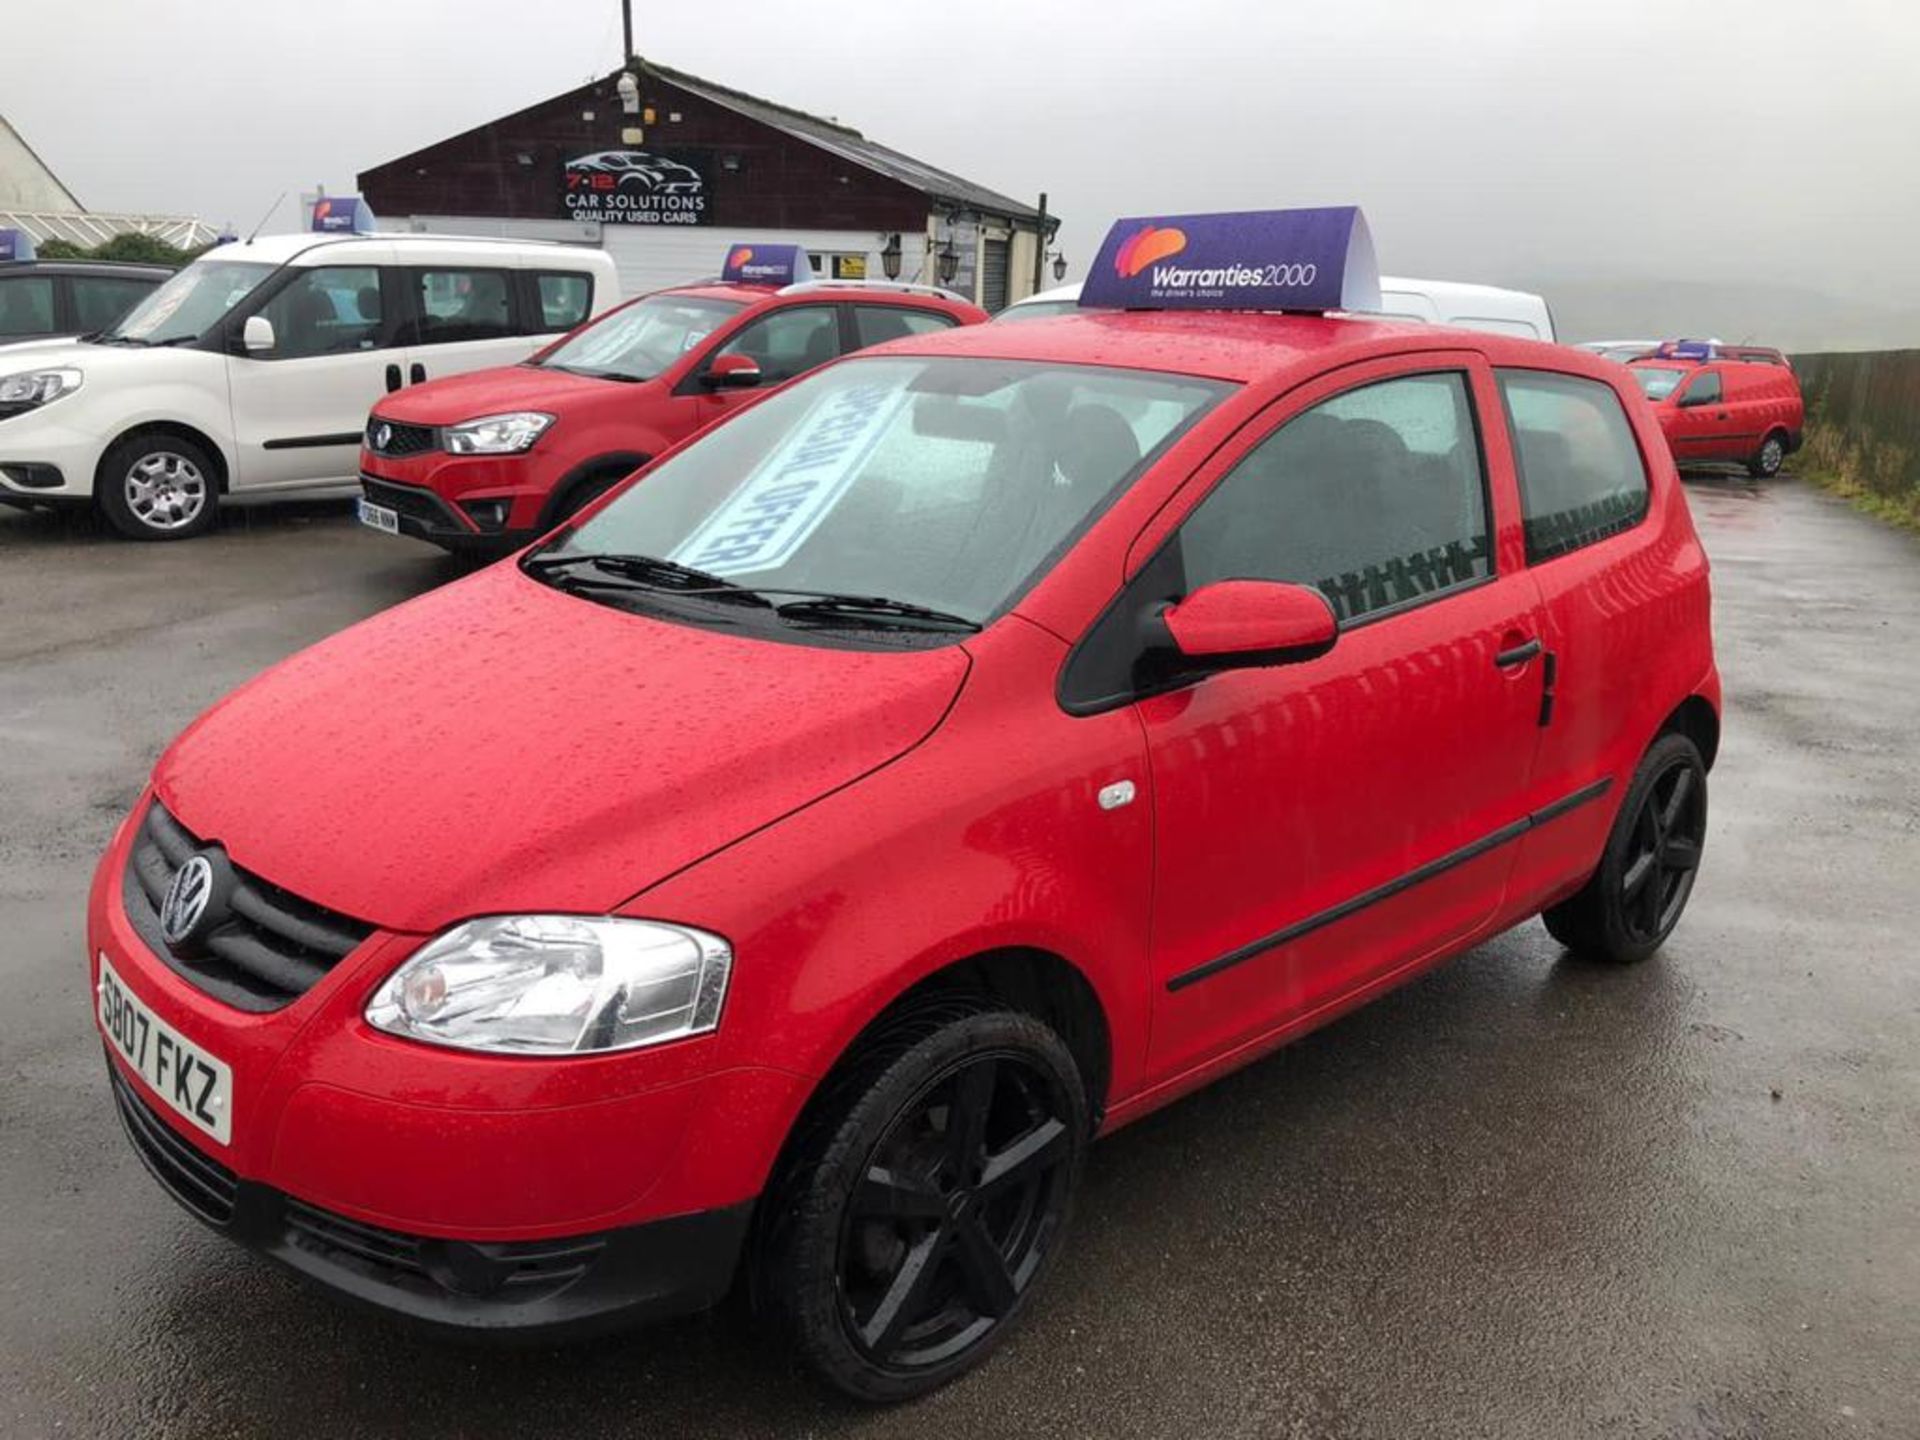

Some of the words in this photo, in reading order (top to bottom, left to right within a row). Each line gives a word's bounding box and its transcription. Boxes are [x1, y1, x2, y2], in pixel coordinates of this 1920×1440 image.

[565, 194, 599, 207] CAR
[606, 195, 705, 211] SOLUTIONS
[573, 210, 624, 222] QUALITY
[627, 211, 660, 223] USED
[663, 212, 698, 224] CARS
[1153, 263, 1317, 287] Warranties2000
[689, 480, 820, 567] OFFER
[104, 972, 149, 1069] SB07
[156, 1031, 217, 1128] FKZ
